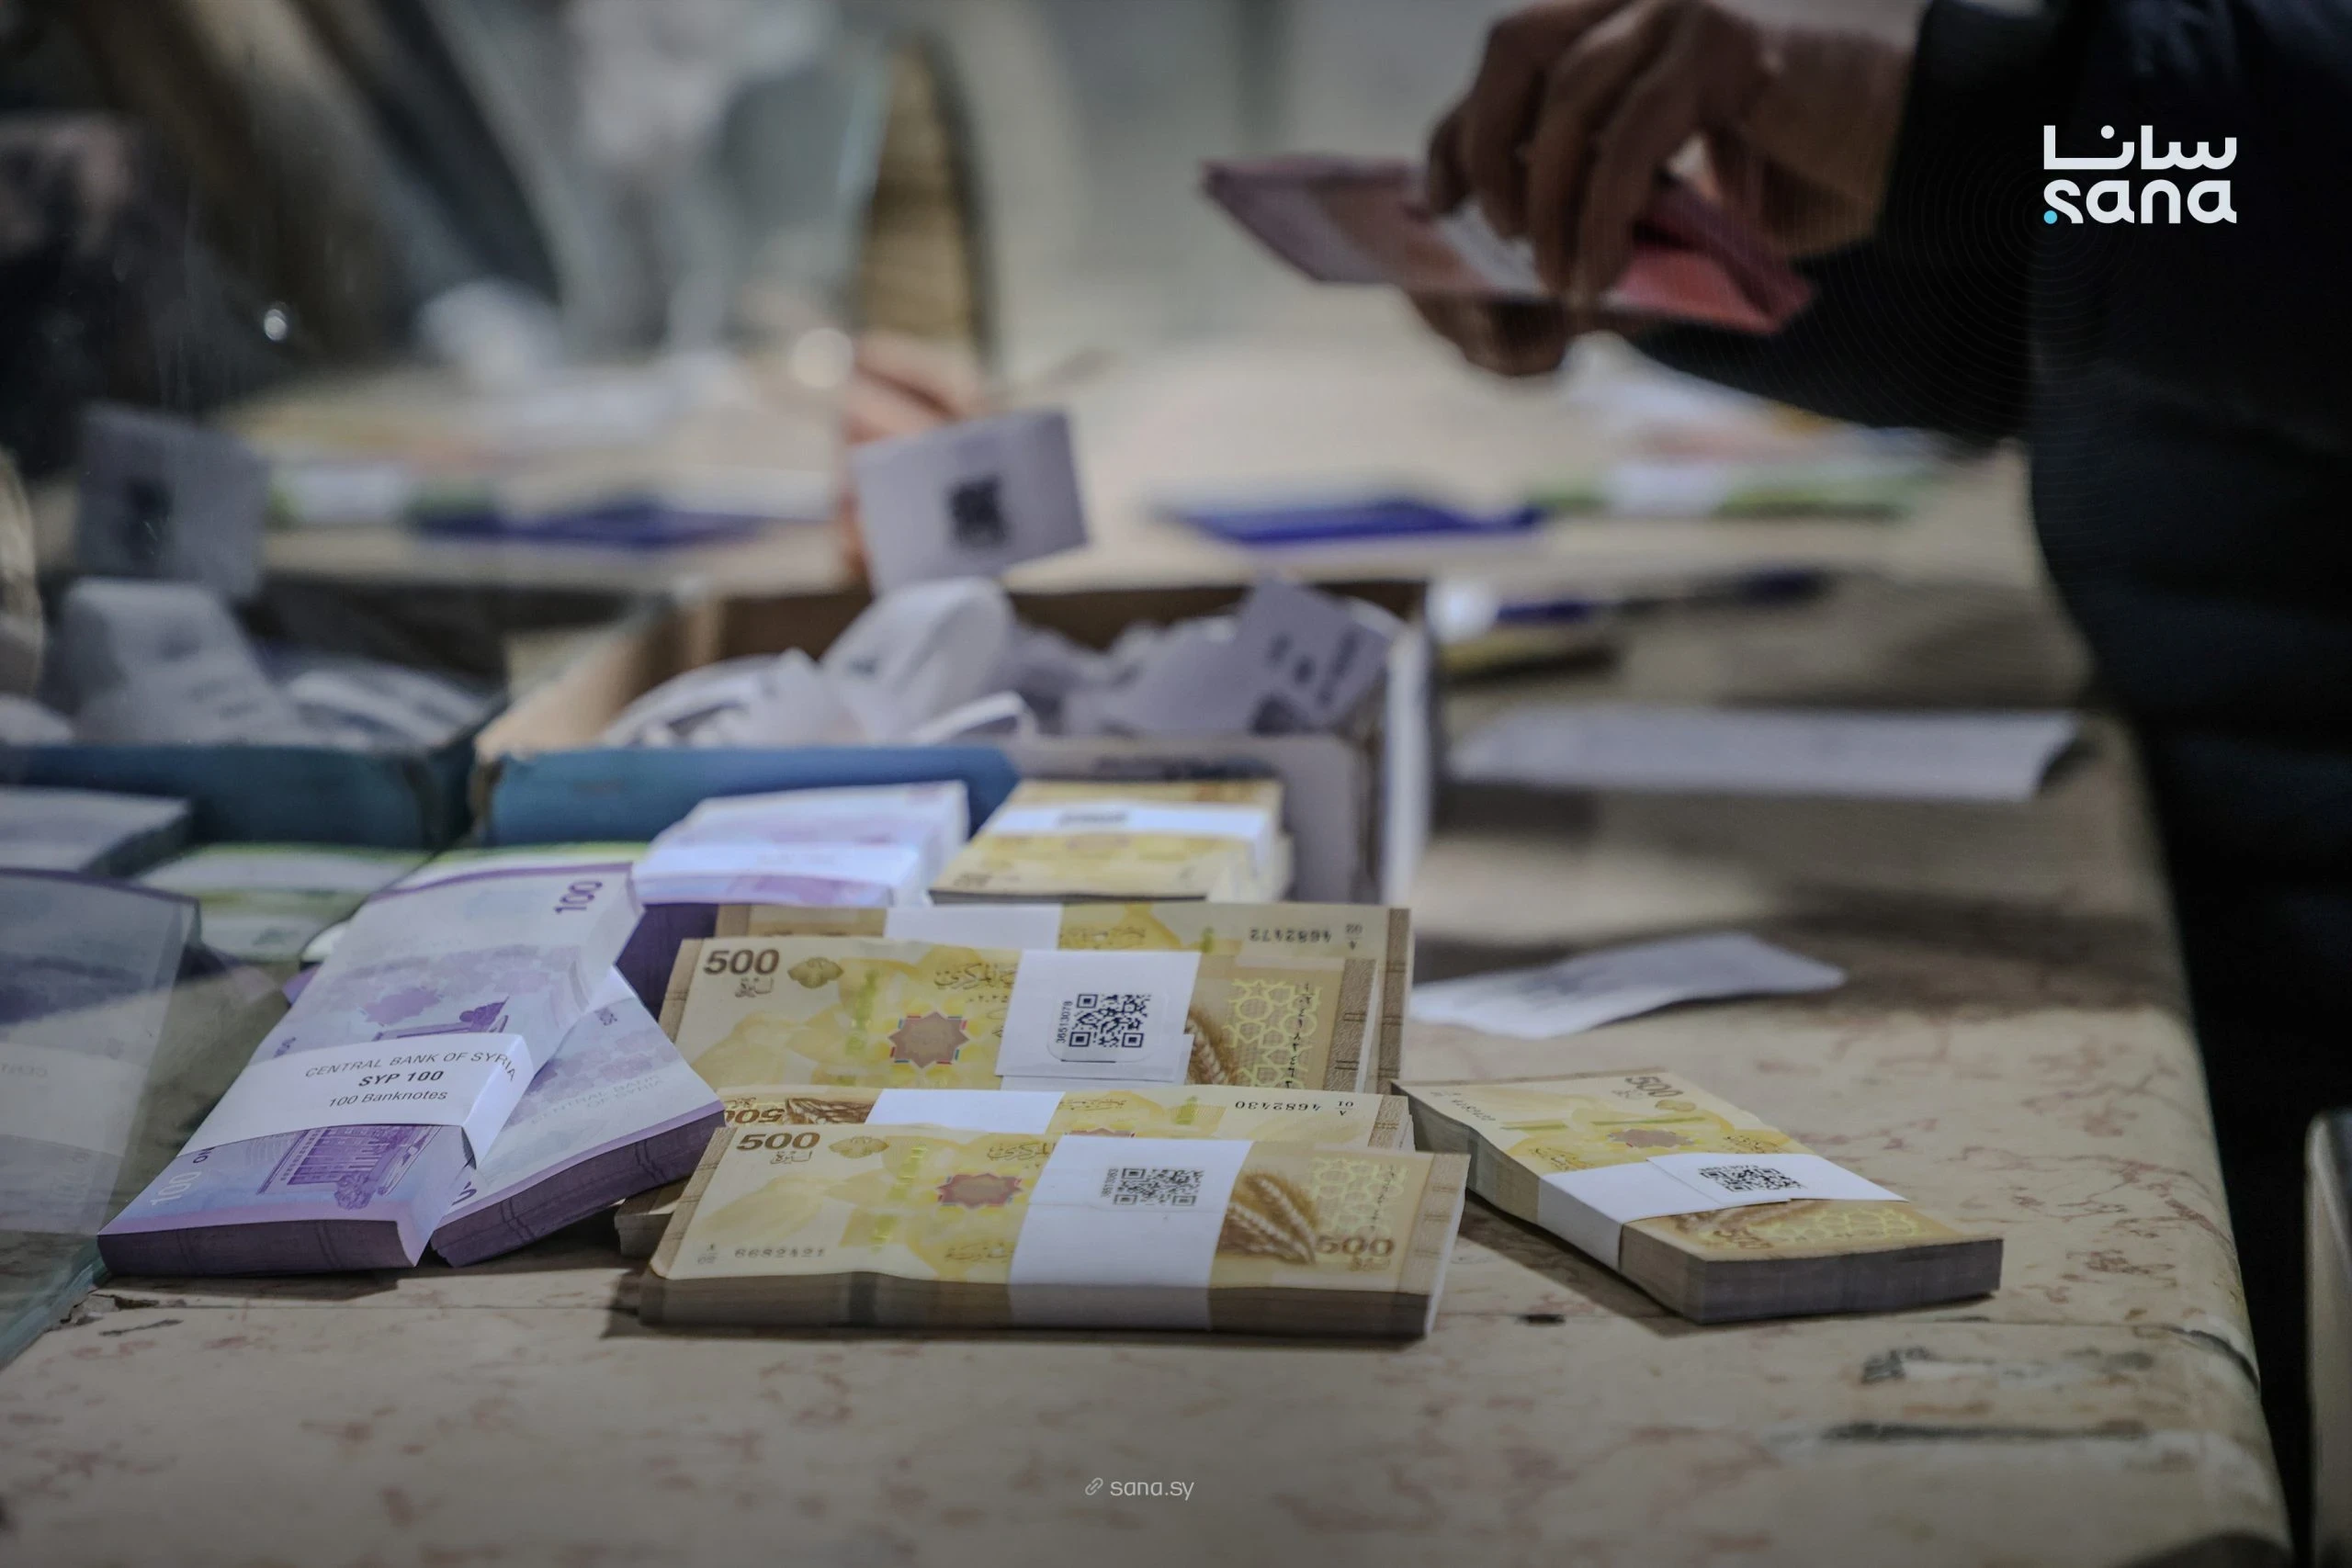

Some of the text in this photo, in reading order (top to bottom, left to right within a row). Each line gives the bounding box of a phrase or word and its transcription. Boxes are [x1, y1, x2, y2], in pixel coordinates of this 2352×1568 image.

[553, 880, 603, 914] 100
[703, 949, 780, 975] 500
[305, 1052, 516, 1082] CENTRAL BANK OF SYRIA
[358, 1070, 445, 1088] SYP 100
[1624, 1076, 1685, 1098] 500
[329, 1089, 448, 1108] 100 Banknotes
[1234, 1100, 1322, 1111] 4682430
[736, 1132, 821, 1151] 500
[150, 1170, 202, 1206] 100
[1315, 1234, 1395, 1258] 500
